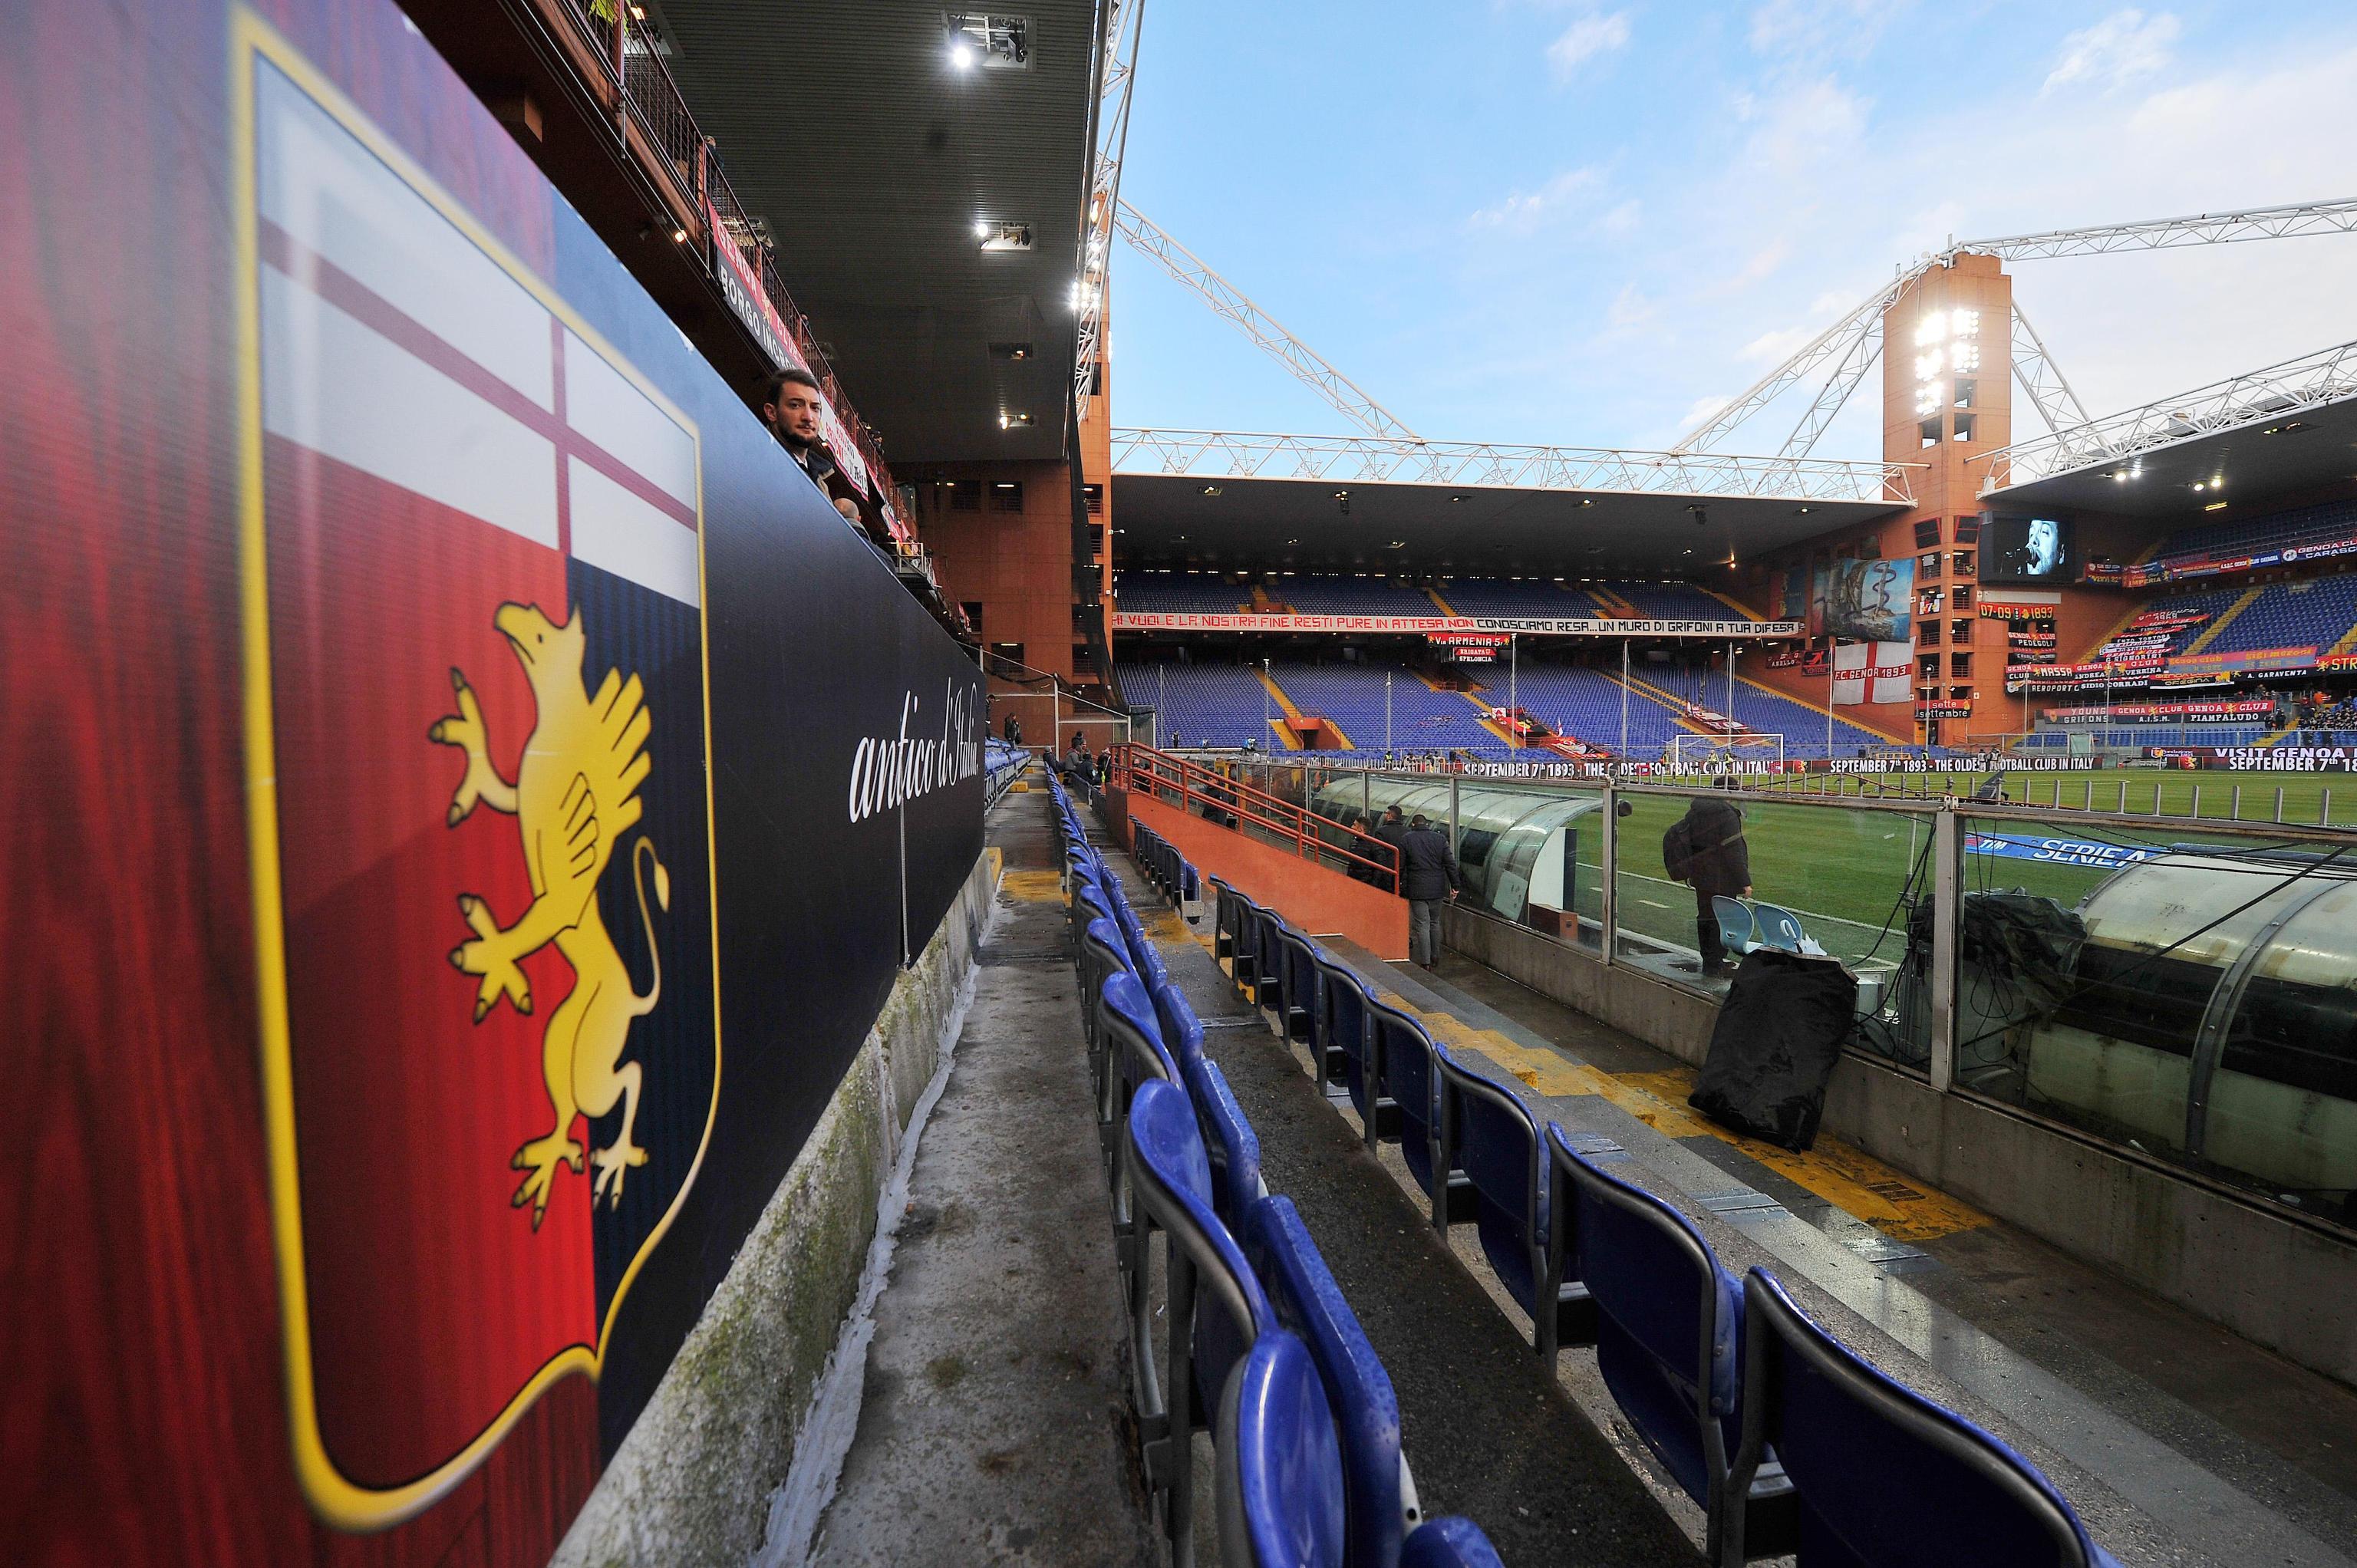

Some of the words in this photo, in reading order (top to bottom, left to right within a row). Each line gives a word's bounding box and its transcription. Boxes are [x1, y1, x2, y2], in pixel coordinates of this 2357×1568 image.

[717, 219, 758, 296] GENOA
[720, 265, 760, 337] BORGO
[2298, 543, 2339, 554] GENOA
[1980, 604, 2011, 618] 07-09
[2031, 606, 2053, 619] 1893
[1129, 614, 1175, 626] VUOLE
[1178, 615, 1198, 626] LA
[1202, 616, 1257, 627] NOSTRA
[1261, 617, 1291, 628] FINE
[1294, 617, 1333, 628] RESTI
[1337, 618, 1373, 628] PURE
[1376, 618, 1388, 628] IN
[1392, 618, 1444, 628] ATTESA
[1447, 619, 1475, 628] NON
[1476, 619, 1552, 631] CONOSCIAMO
[1618, 621, 1650, 631] MURO
[1654, 622, 1664, 631] DI
[1668, 622, 1713, 632] GRIFONI
[1716, 623, 1724, 633] A
[1728, 623, 1751, 633] TUA
[1755, 624, 1795, 633] DIFESA
[1449, 637, 1492, 646] ARMENIA
[2114, 653, 2162, 662] SIGNORINI
[1850, 668, 1879, 680] GENOA
[1881, 666, 1907, 677] 1893
[2041, 667, 2073, 677] MASSA
[2075, 671, 2105, 680] ANDREA
[2258, 669, 2307, 678] GARAVENTA
[2107, 680, 2148, 688] CORRADI
[2164, 677, 2210, 686] OREGINA
[1932, 700, 1956, 709] sette
[2187, 704, 2223, 713] GENOA
[2239, 703, 2269, 711] CLUB
[1920, 709, 1968, 718] settembre
[2064, 715, 2109, 723] GRIFONS
[2190, 713, 2260, 722] PIAMPALUDO
[849, 690, 936, 824] antico
[2215, 747, 2267, 758] VISIT
[2272, 747, 2345, 758] GENOA
[1464, 762, 1530, 777] SEPTEMBER
[1548, 763, 1574, 777] 1893
[1584, 763, 1605, 776] THE
[1732, 760, 1743, 773] IN
[1830, 759, 1887, 773] SEPTEMBER
[1889, 759, 1901, 772] 7th
[1904, 759, 1927, 772] 1893
[1935, 759, 1953, 772] THE
[2035, 757, 2057, 770] CLUB
[2059, 757, 2069, 770] IN
[2070, 757, 2095, 770] ITALY
[2229, 756, 2315, 771] SEPTEMBER
[2319, 756, 2339, 772] 7th
[1980, 838, 2009, 850] TIM
[2033, 839, 2125, 866] SERIE
